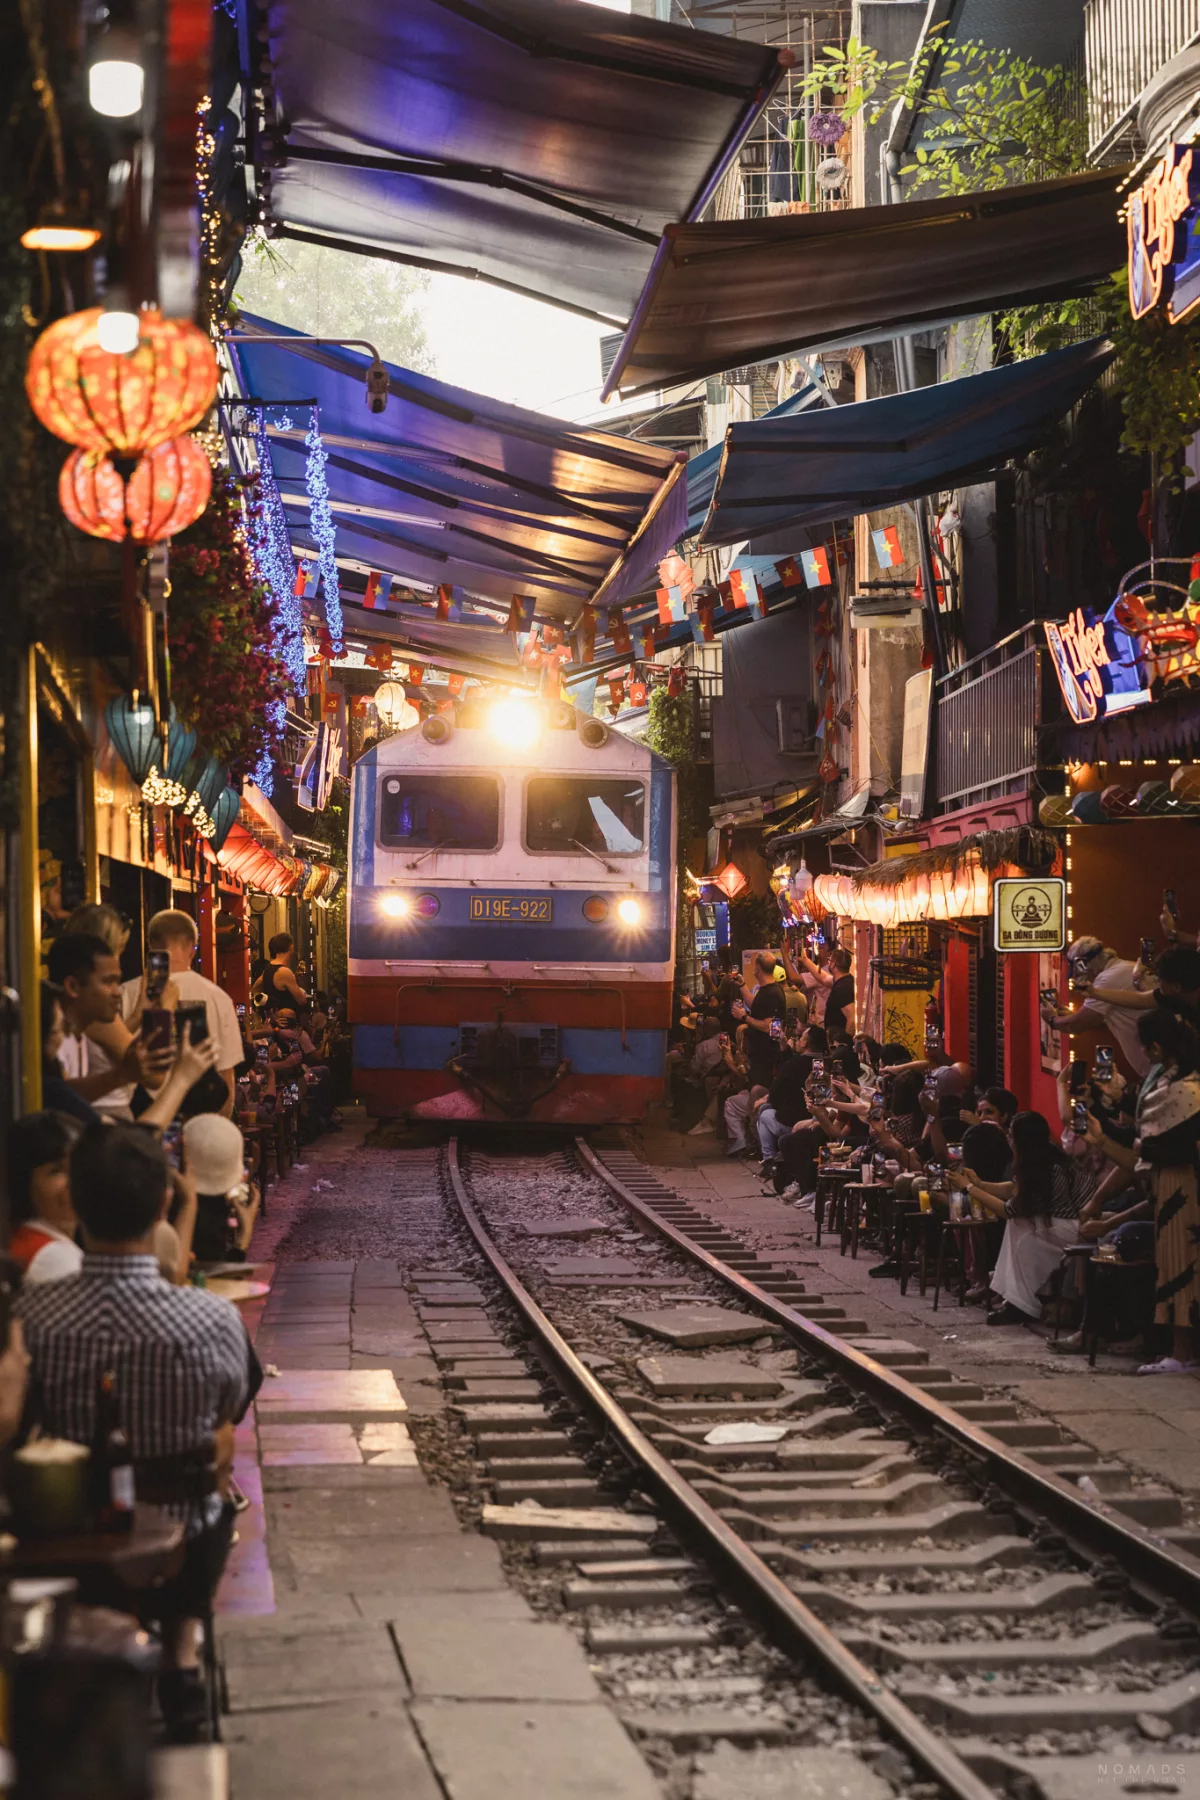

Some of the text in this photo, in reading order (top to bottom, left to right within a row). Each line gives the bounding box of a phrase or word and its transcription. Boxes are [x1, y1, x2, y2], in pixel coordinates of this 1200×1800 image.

[1059, 608, 1111, 700] Tiger
[474, 899, 548, 919] D19E-922
[1002, 930, 1012, 940] GA
